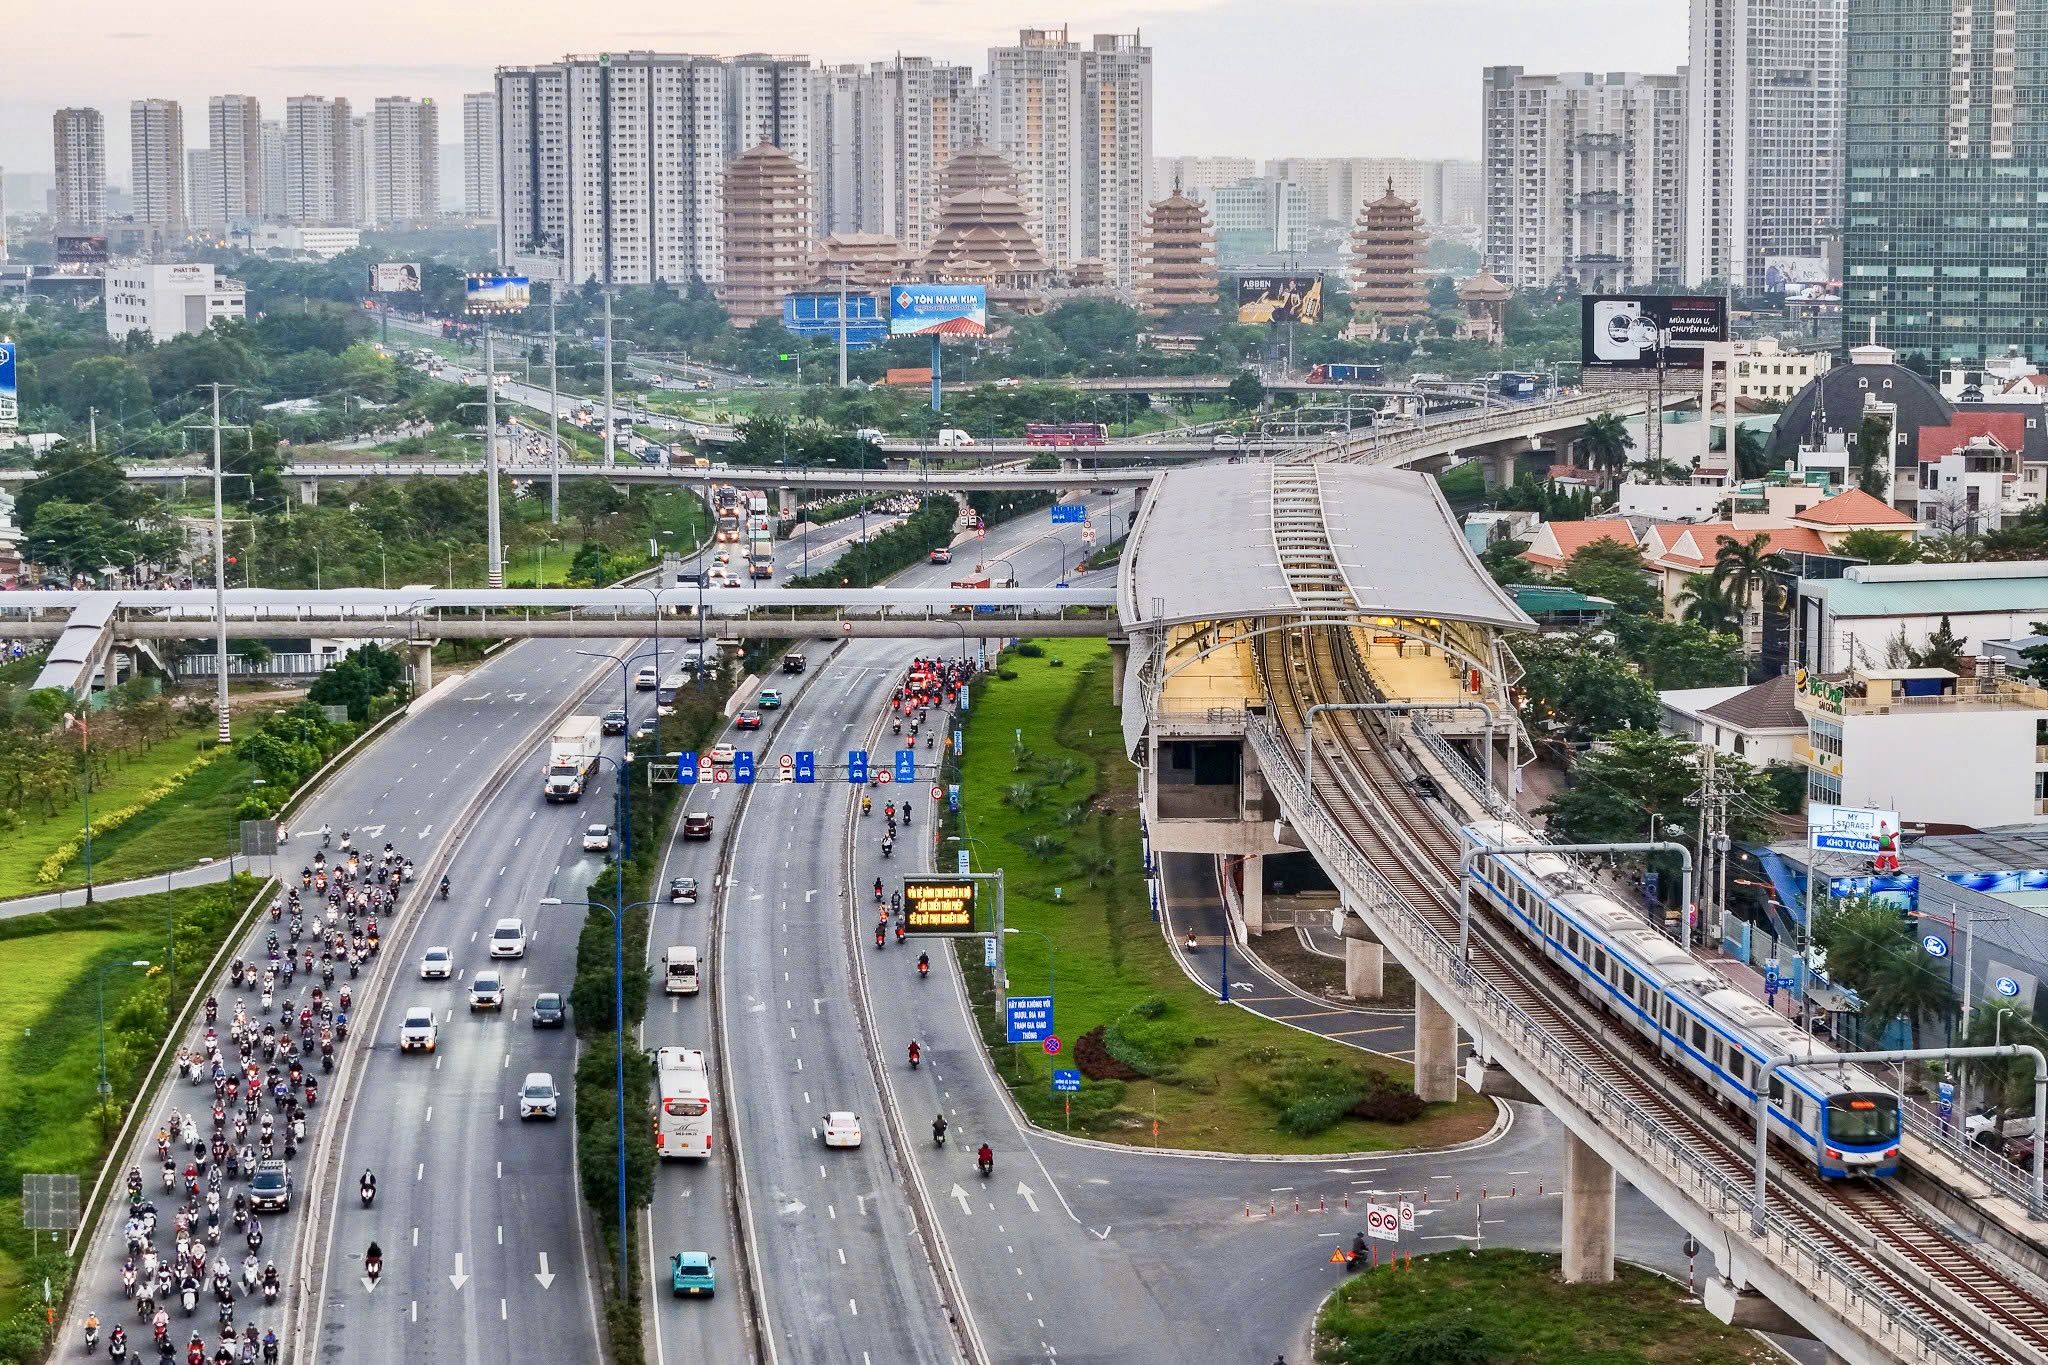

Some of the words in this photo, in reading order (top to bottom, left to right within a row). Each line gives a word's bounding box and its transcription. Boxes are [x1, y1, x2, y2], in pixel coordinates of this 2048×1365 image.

[914, 294, 933, 304] TÔN
[961, 296, 978, 304] KIM
[1669, 316, 1685, 324] MÙA
[1671, 325, 1699, 333] CHUYỆN
[1837, 821, 1869, 830] STORAGE
[1844, 840, 1856, 849] TỰ
[1027, 1000, 1042, 1008] KHÔNG
[1022, 1031, 1037, 1040] THÔNG
